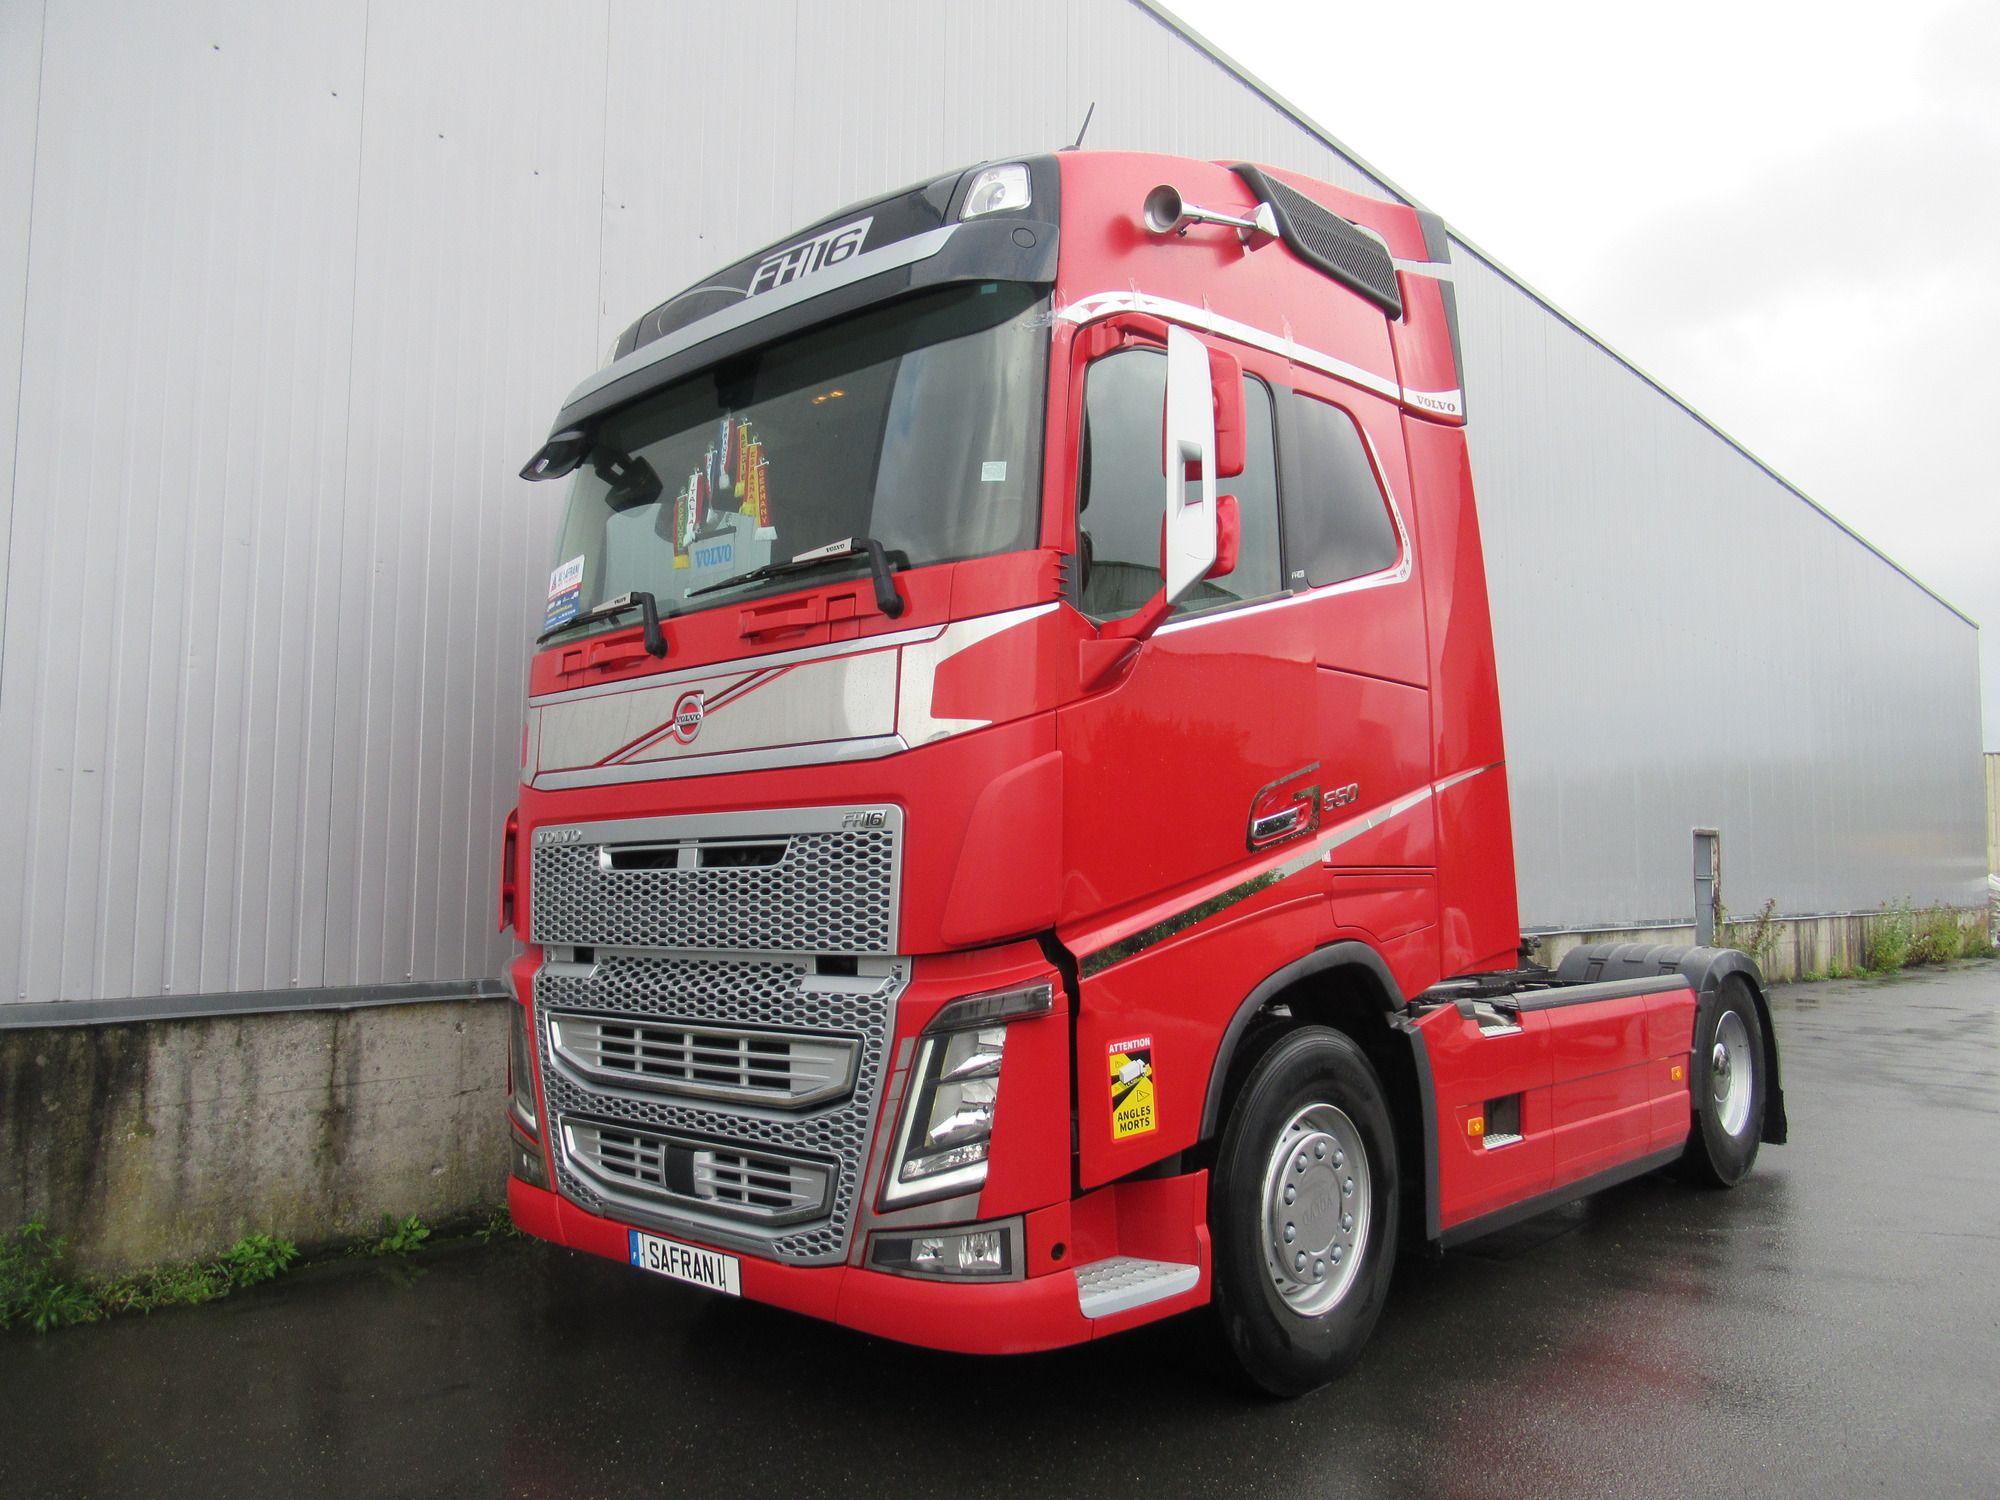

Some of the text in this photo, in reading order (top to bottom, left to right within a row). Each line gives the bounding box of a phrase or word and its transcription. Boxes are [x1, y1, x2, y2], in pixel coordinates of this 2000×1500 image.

[746, 216, 873, 298] FH16
[1417, 395, 1456, 412] VOLVO
[689, 481, 697, 524] ITALIA
[695, 543, 732, 568] VOLVO
[676, 713, 702, 723] VOLVO
[1323, 782, 1360, 812] 550
[842, 809, 888, 829] FH16
[539, 829, 582, 845] VOLVO
[1108, 1037, 1151, 1054] ATTENTION
[1117, 1105, 1151, 1122] ANGLES
[1119, 1117, 1150, 1133] MORTS
